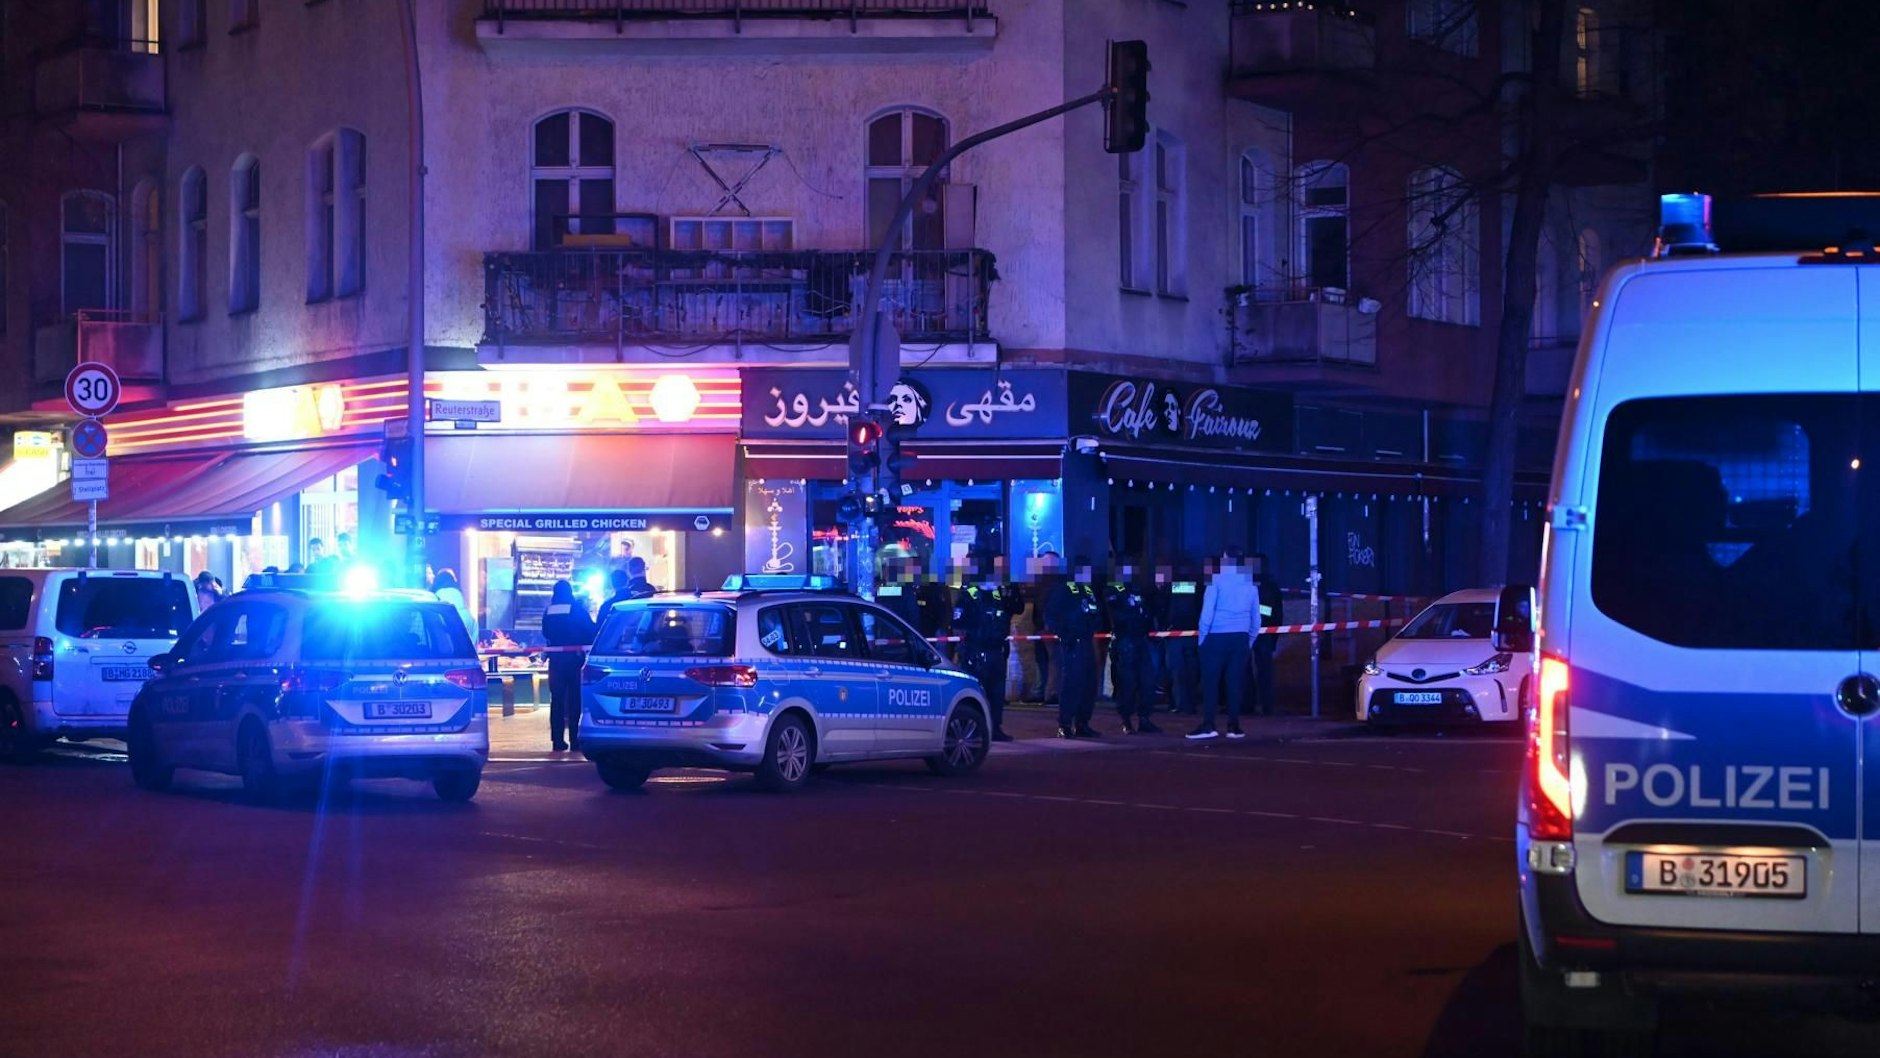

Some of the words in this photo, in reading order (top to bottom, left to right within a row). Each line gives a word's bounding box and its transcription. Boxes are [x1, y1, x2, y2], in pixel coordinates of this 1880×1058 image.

[78, 378, 108, 401] 30
[435, 403, 495, 417] Reuterstraße
[1106, 381, 1158, 439] Cafe
[480, 519, 532, 529] SPECIAL
[535, 519, 588, 529] GRILLED
[591, 519, 647, 529] CHICKEN
[607, 680, 638, 690] POLIZEI
[642, 697, 670, 709] 30493
[889, 689, 931, 706] POLIZEI
[378, 704, 386, 715] B
[392, 703, 426, 715] 30203
[1605, 763, 1829, 809] POLIZEI
[1660, 860, 1677, 886] B
[1699, 860, 1788, 888] 31905
